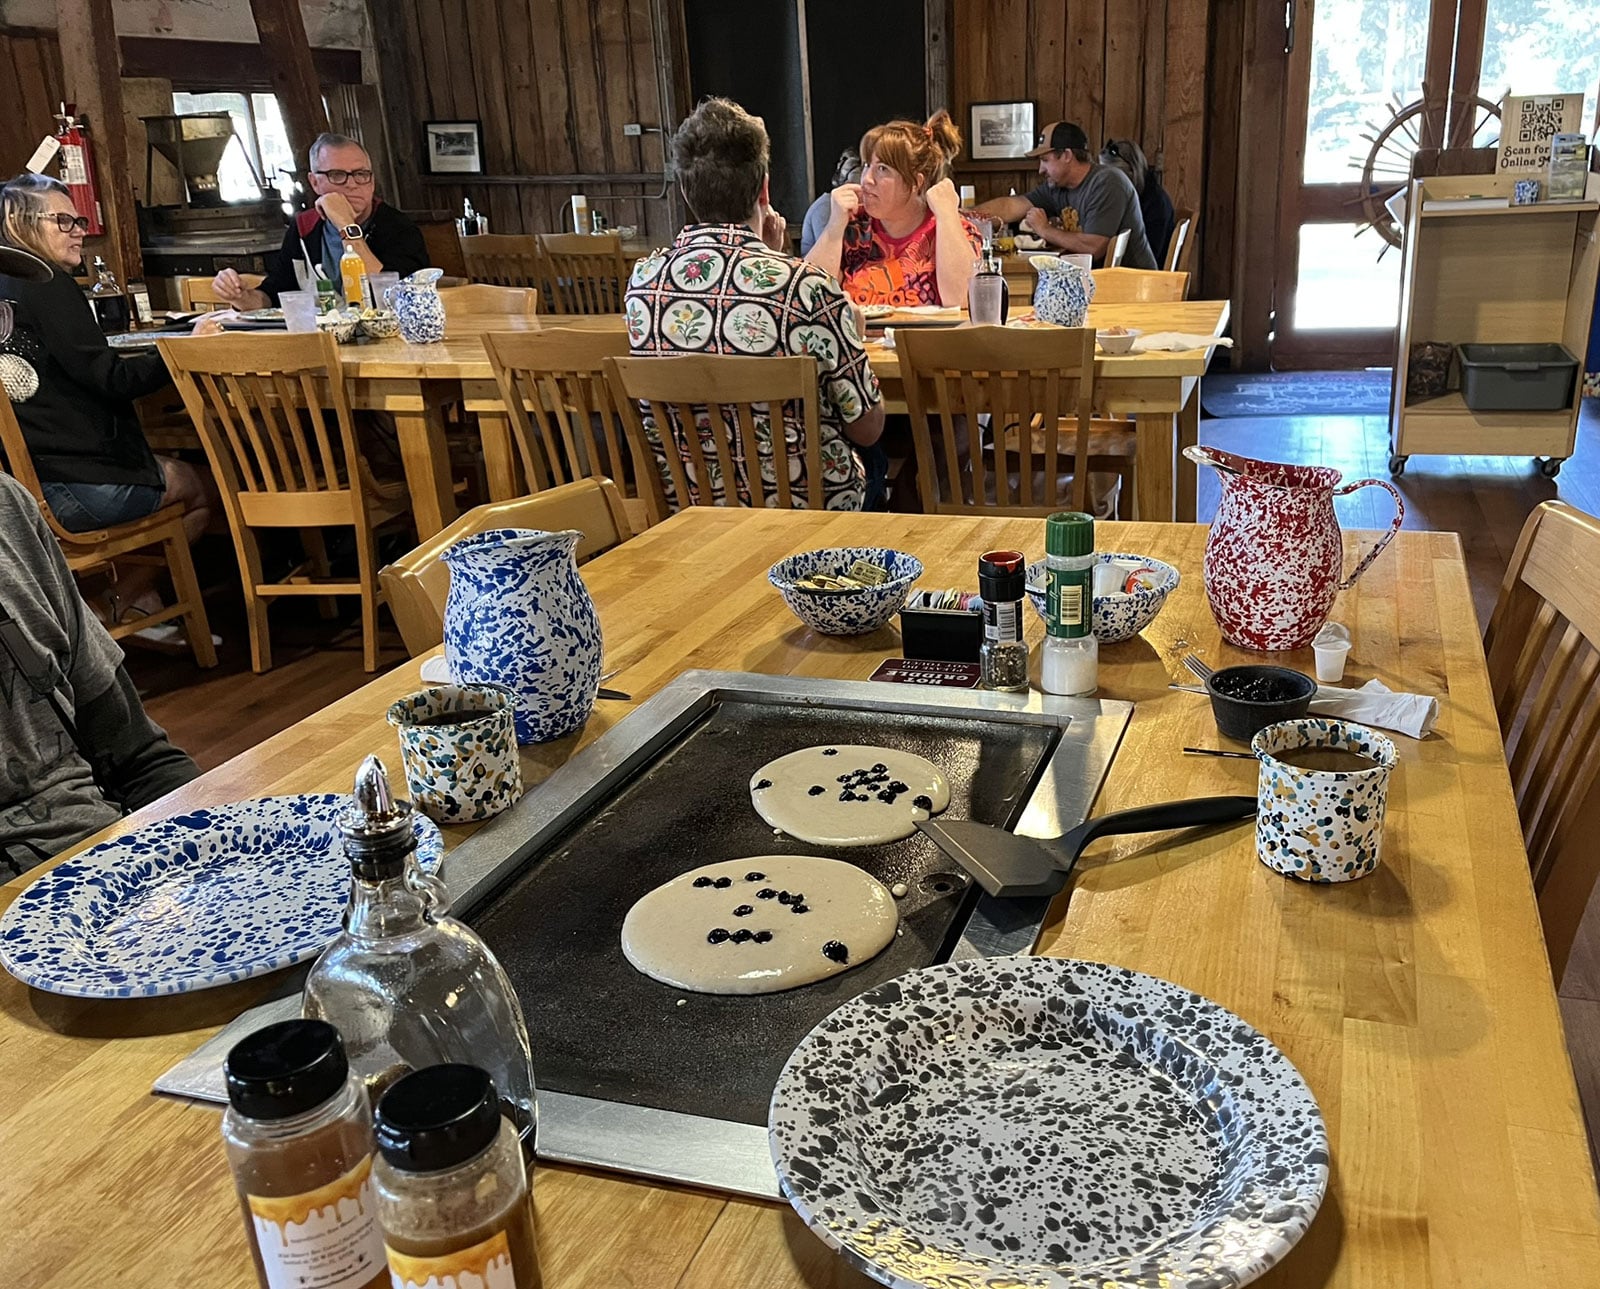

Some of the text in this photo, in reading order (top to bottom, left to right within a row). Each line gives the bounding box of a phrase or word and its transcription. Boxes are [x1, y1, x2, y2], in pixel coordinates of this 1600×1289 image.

[1504, 145, 1530, 157] Scan
[1534, 144, 1550, 154] for
[1500, 156, 1536, 168] Online
[886, 670, 969, 680] GRIDDLE
[903, 677, 943, 685] HOT
